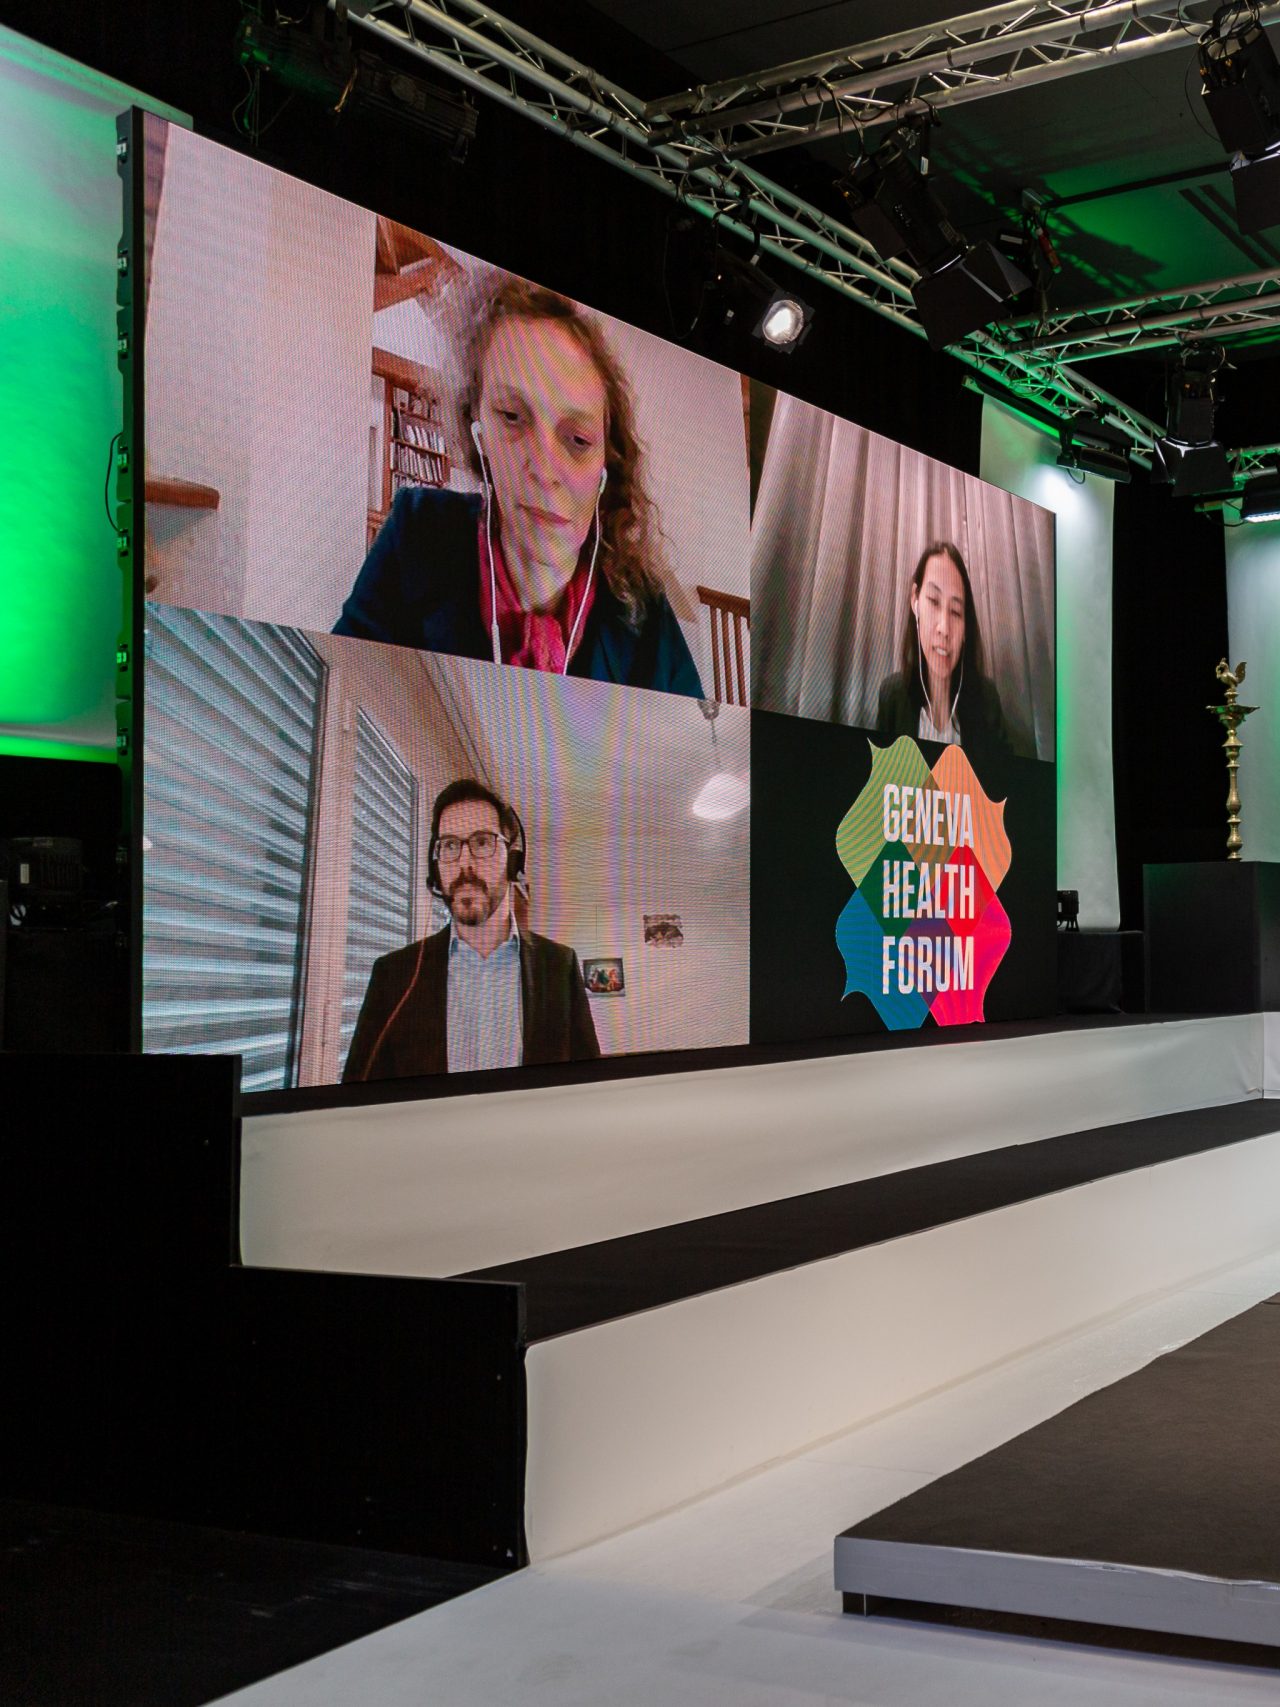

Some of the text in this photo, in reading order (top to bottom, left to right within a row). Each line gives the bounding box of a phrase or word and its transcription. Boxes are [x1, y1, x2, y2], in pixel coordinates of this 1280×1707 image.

[883, 783, 974, 848] GENEVA
[883, 859, 975, 919] HEALTH
[882, 936, 974, 994] FORUM
